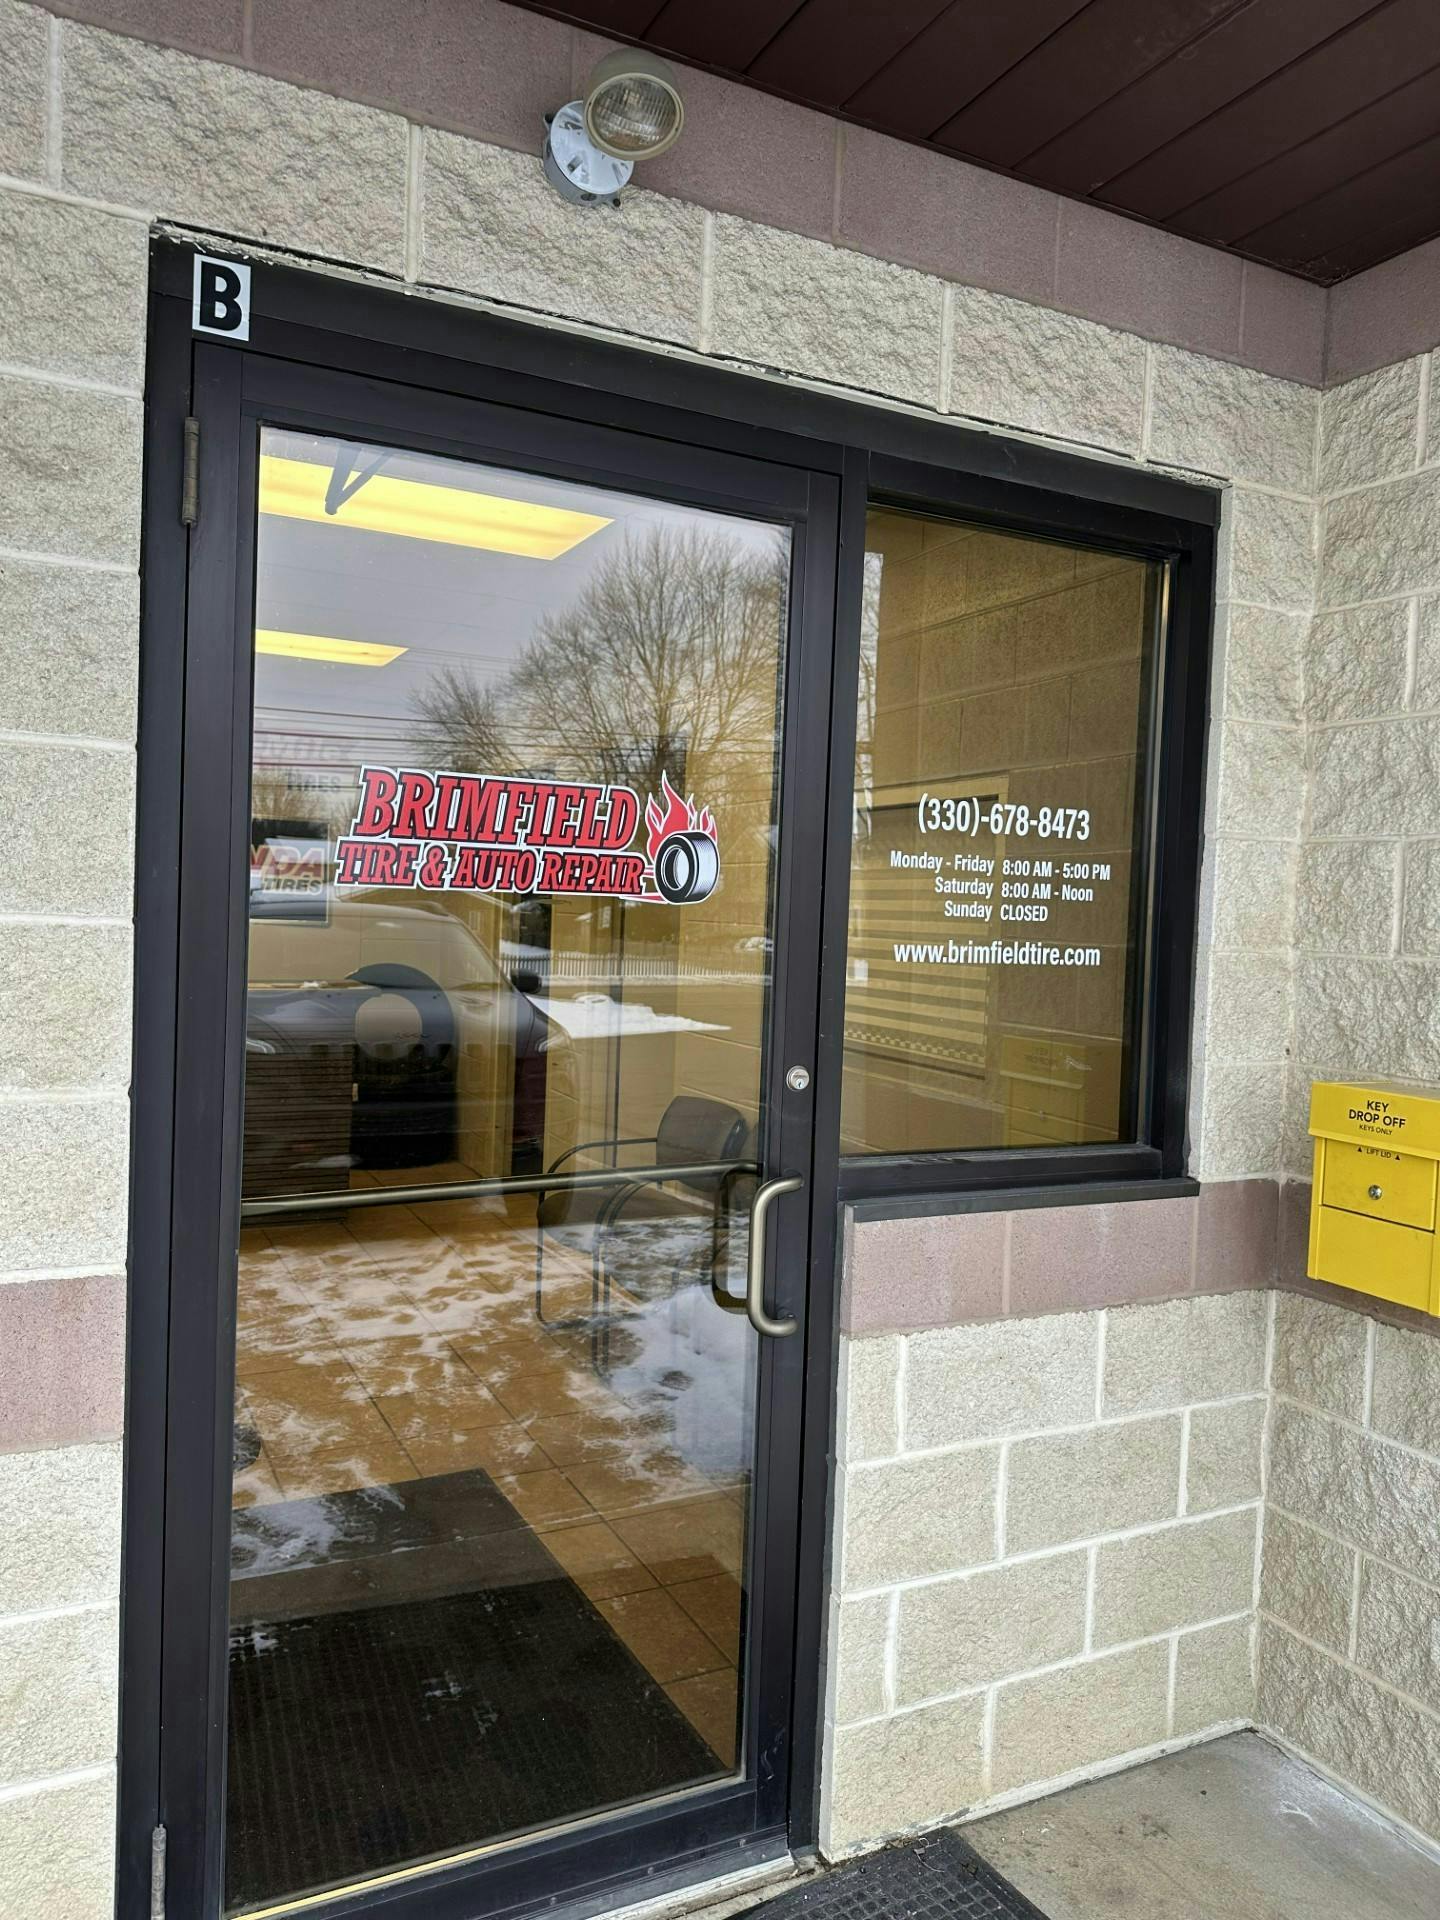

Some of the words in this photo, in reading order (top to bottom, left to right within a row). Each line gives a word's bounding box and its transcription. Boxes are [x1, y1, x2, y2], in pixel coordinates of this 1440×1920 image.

[200, 261, 242, 331] B
[353, 766, 641, 851] BRIMFIELD
[918, 793, 1090, 841] (330)-678-8473
[338, 840, 419, 886] TIRE
[419, 843, 448, 889] &
[451, 848, 538, 893] AUTO
[538, 852, 646, 895] REPAIR
[890, 850, 943, 873] Monday
[954, 854, 994, 877] Friday
[1002, 860, 1030, 876] 8:00
[1033, 861, 1051, 877] AM
[1063, 863, 1090, 879] 5:00
[1092, 864, 1110, 880] PM
[263, 877, 322, 894] TIRES
[935, 877, 993, 899] Saturday
[1002, 882, 1029, 898] 8:00
[1032, 883, 1051, 899] AM
[1061, 885, 1093, 902] Noon
[944, 901, 993, 922] Sunday
[1000, 904, 1049, 922] CLOSED
[894, 940, 1101, 966] www.brimfieldtire.com
[1349, 1109, 1380, 1123] DROP
[1383, 1116, 1406, 1128] OFF
[1367, 1100, 1389, 1112] KEY
[1359, 1124, 1374, 1132] KEYS
[1376, 1127, 1392, 1135] ONLY
[1367, 1148, 1379, 1156] LIFT
